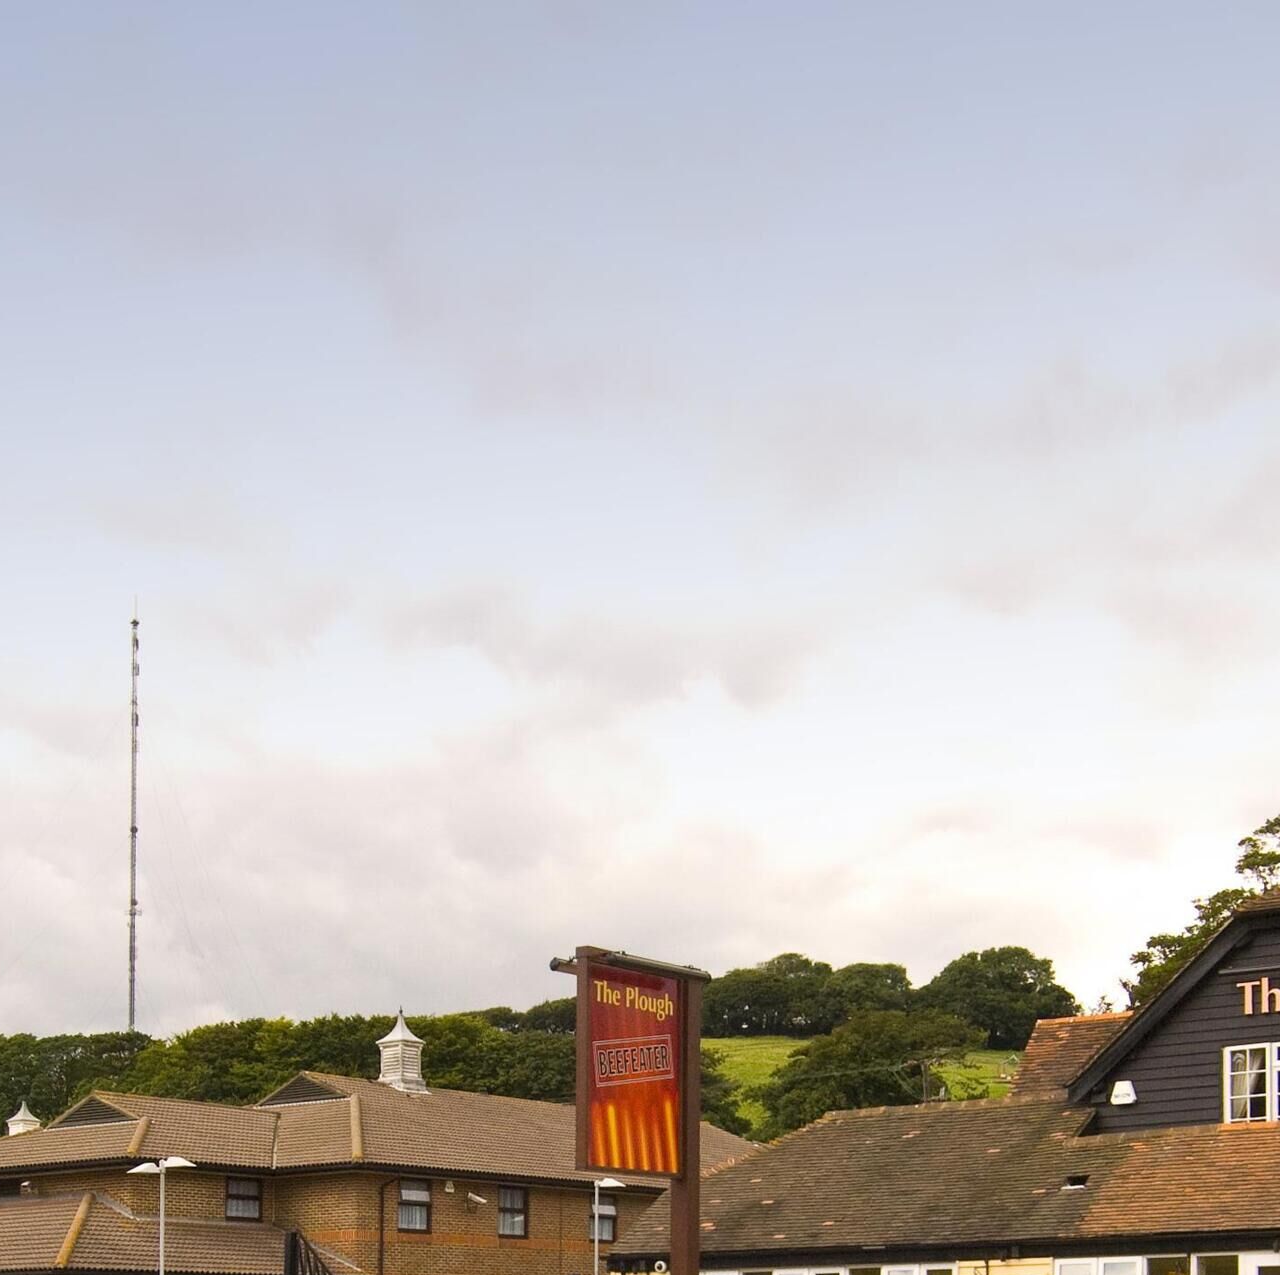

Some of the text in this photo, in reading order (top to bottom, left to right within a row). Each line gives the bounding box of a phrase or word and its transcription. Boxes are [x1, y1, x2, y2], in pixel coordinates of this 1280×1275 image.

[593, 980, 674, 1021] The Plough
[597, 1043, 671, 1078] BEEFEATER
